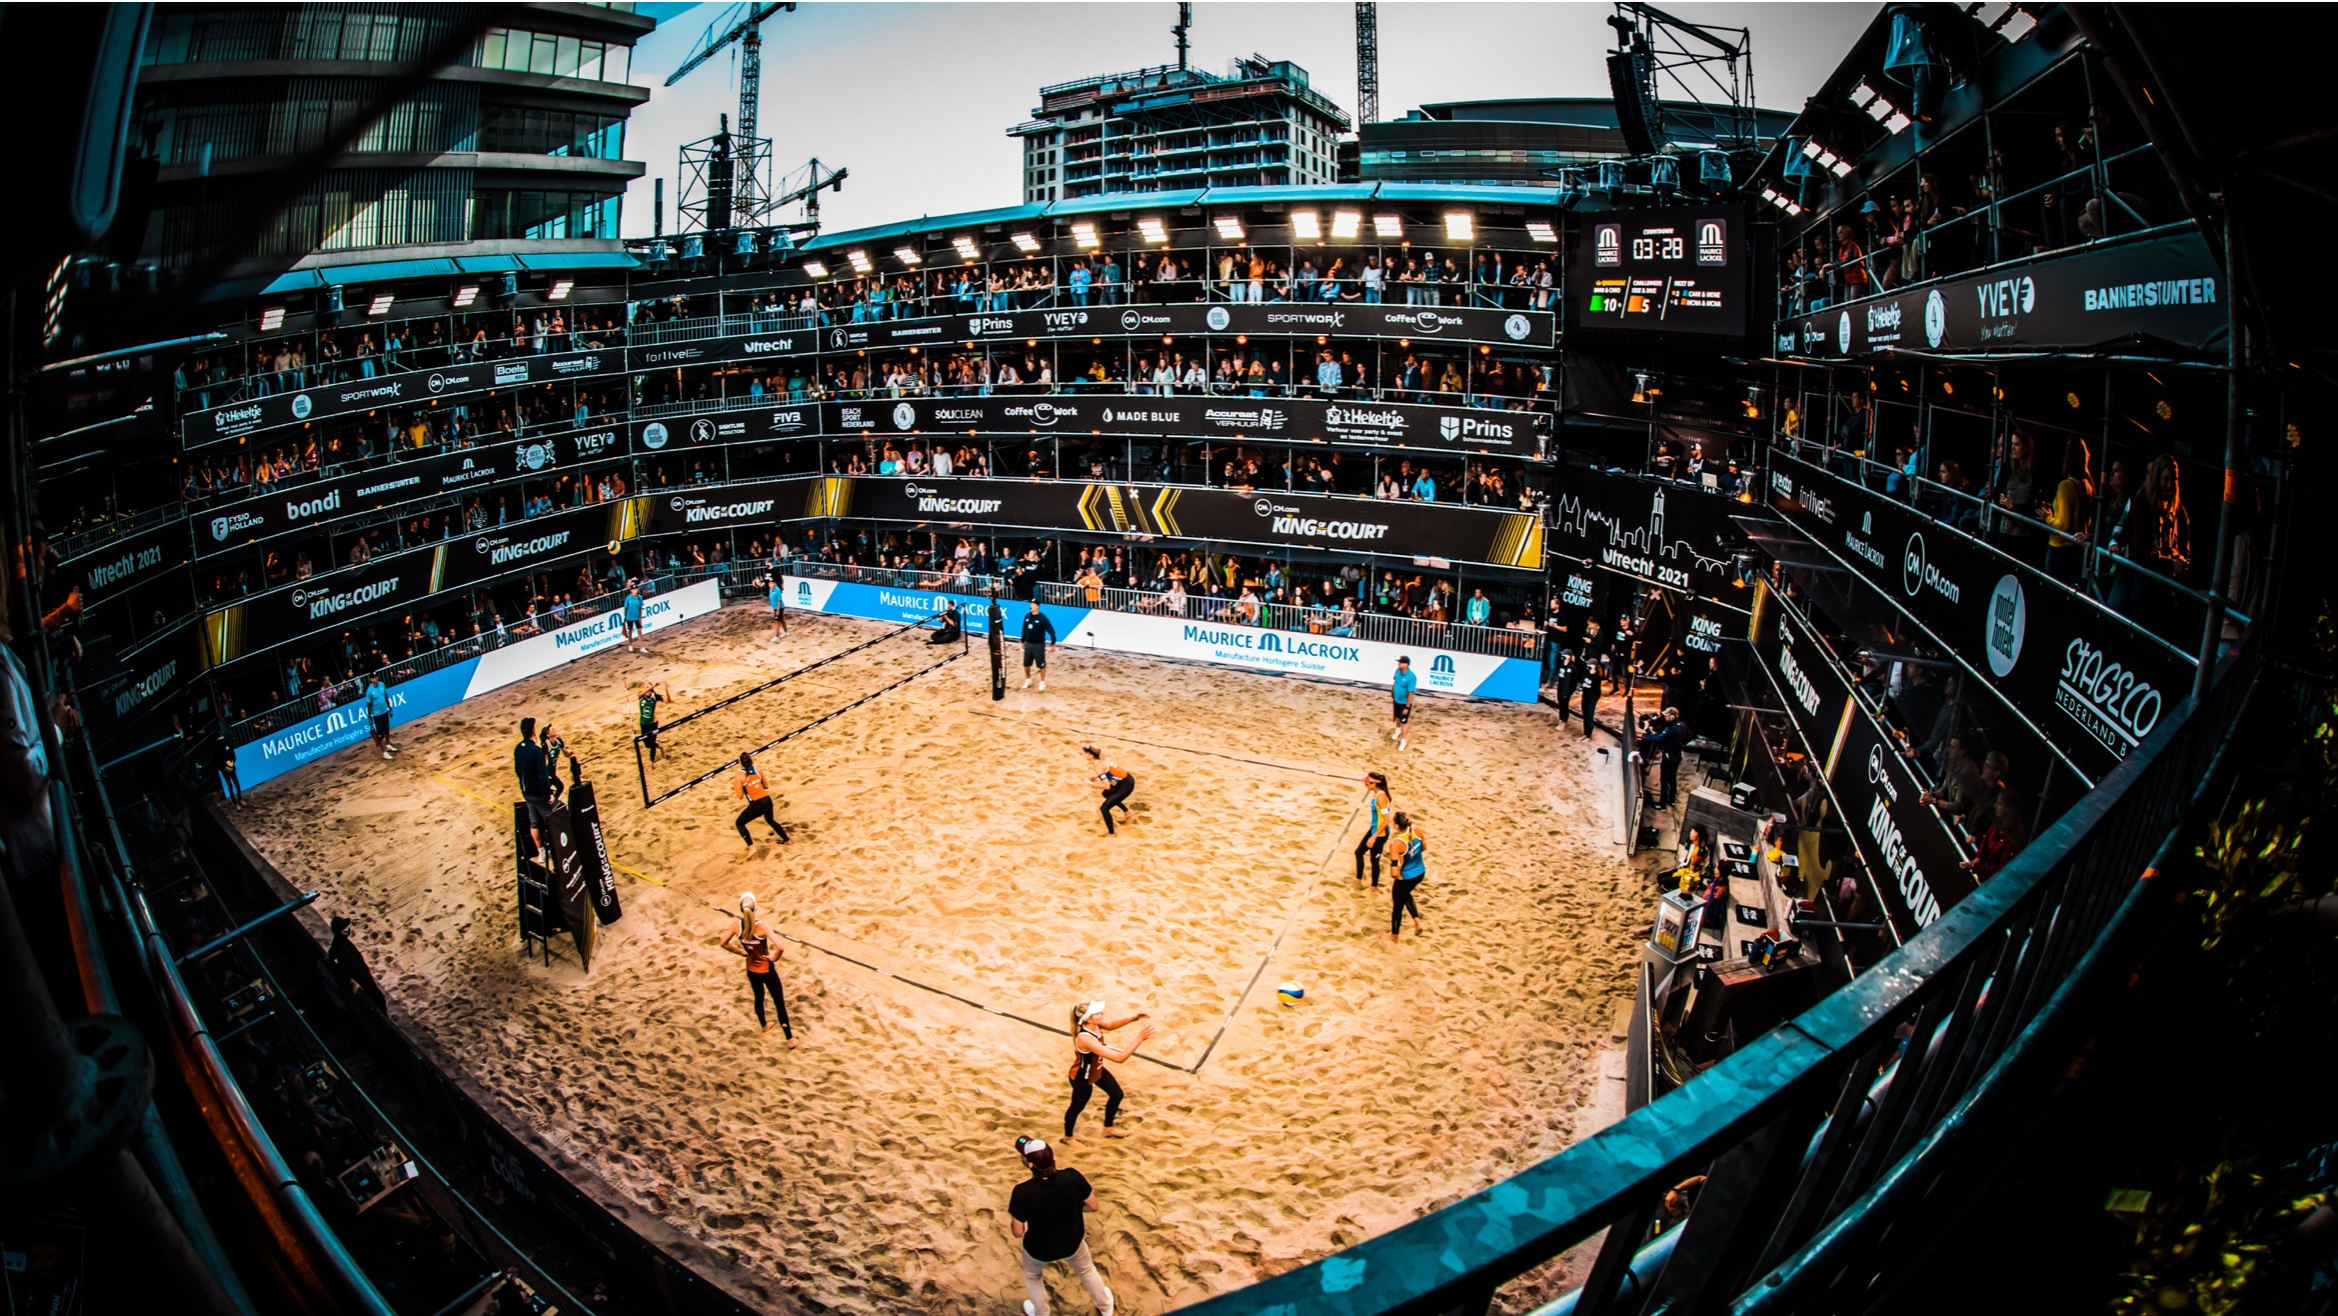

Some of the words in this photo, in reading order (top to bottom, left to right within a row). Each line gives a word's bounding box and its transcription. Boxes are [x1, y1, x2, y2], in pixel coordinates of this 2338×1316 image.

[1633, 238, 1683, 260] 03:28
[1977, 279, 2021, 318] YVEY
[2085, 277, 2216, 311] BANNERSTUNTER
[1604, 299, 1617, 312] 10
[1641, 299, 1650, 312] 5
[982, 318, 1012, 330] Prins
[1044, 312, 1078, 326] YVEY
[1141, 316, 1170, 324] CM.com
[1385, 314, 1416, 324] Coffee
[1438, 316, 1462, 326] Work
[1513, 320, 1521, 332] 4
[1931, 305, 1937, 328] 4
[744, 338, 792, 352] Utrecht
[446, 375, 469, 385] CM.com
[496, 364, 526, 376] Boels
[899, 410, 908, 422] 4
[1005, 407, 1033, 416] Coffee
[1053, 407, 1078, 416] Work
[1116, 412, 1148, 421] MADE
[1151, 413, 1180, 422] BLUE
[1206, 408, 1258, 418] Accuraat
[1350, 409, 1404, 429] Hekeltje
[841, 420, 875, 428] NEDERLAND
[1215, 420, 1259, 428] VERHUUR
[1463, 418, 1513, 438] Prins
[575, 434, 606, 450] YVEY
[442, 473, 469, 485] MAURICE
[470, 467, 496, 479] LACROIX
[287, 489, 340, 520] bondi
[686, 506, 720, 522] KING
[728, 500, 774, 517] COURT
[918, 498, 950, 512] KING
[957, 498, 1001, 513] COURT
[229, 512, 250, 524] FYSIO
[229, 516, 264, 532] HOLLAND
[1272, 516, 1317, 536] KING
[1327, 521, 1388, 539] COURT
[491, 545, 522, 565] KING
[530, 531, 569, 555] COURT
[1845, 531, 1865, 556] MAURICE
[1864, 541, 1885, 569] LACROIX
[88, 552, 134, 590] Utrecht
[138, 545, 162, 572] 2021
[1602, 548, 1654, 577] Utrecht
[1658, 566, 1689, 587] 2021
[1567, 574, 1593, 594] KING
[1925, 563, 1960, 604] CM.com
[310, 593, 345, 619] KING
[352, 577, 399, 604] COURT
[880, 591, 929, 610] MAURICE
[1562, 590, 1593, 608] COURT
[555, 621, 605, 648] MAURICE
[1691, 615, 1722, 638] KING
[580, 636, 612, 651] Manufacture
[1183, 625, 1253, 649] MAURICE
[1287, 638, 1359, 662] LACROIX
[1215, 650, 1260, 664] Manufacture
[1262, 655, 1299, 669] Horlogère
[1301, 661, 1326, 671] Suisse
[115, 683, 142, 717] KING
[146, 659, 176, 695] COURT
[1429, 679, 1453, 687] LACROIX
[1430, 674, 1454, 682] MAURICE
[1780, 644, 1797, 685] KING
[1796, 670, 1820, 716] COURT
[2061, 638, 2161, 737] STAGECO
[2055, 687, 2116, 746] NEDERLAND
[262, 723, 323, 760] MAURICE
[295, 740, 333, 760] Manufacture
[591, 822, 606, 858] COURT
[1867, 792, 1902, 869] KING
[601, 864, 616, 891] KING
